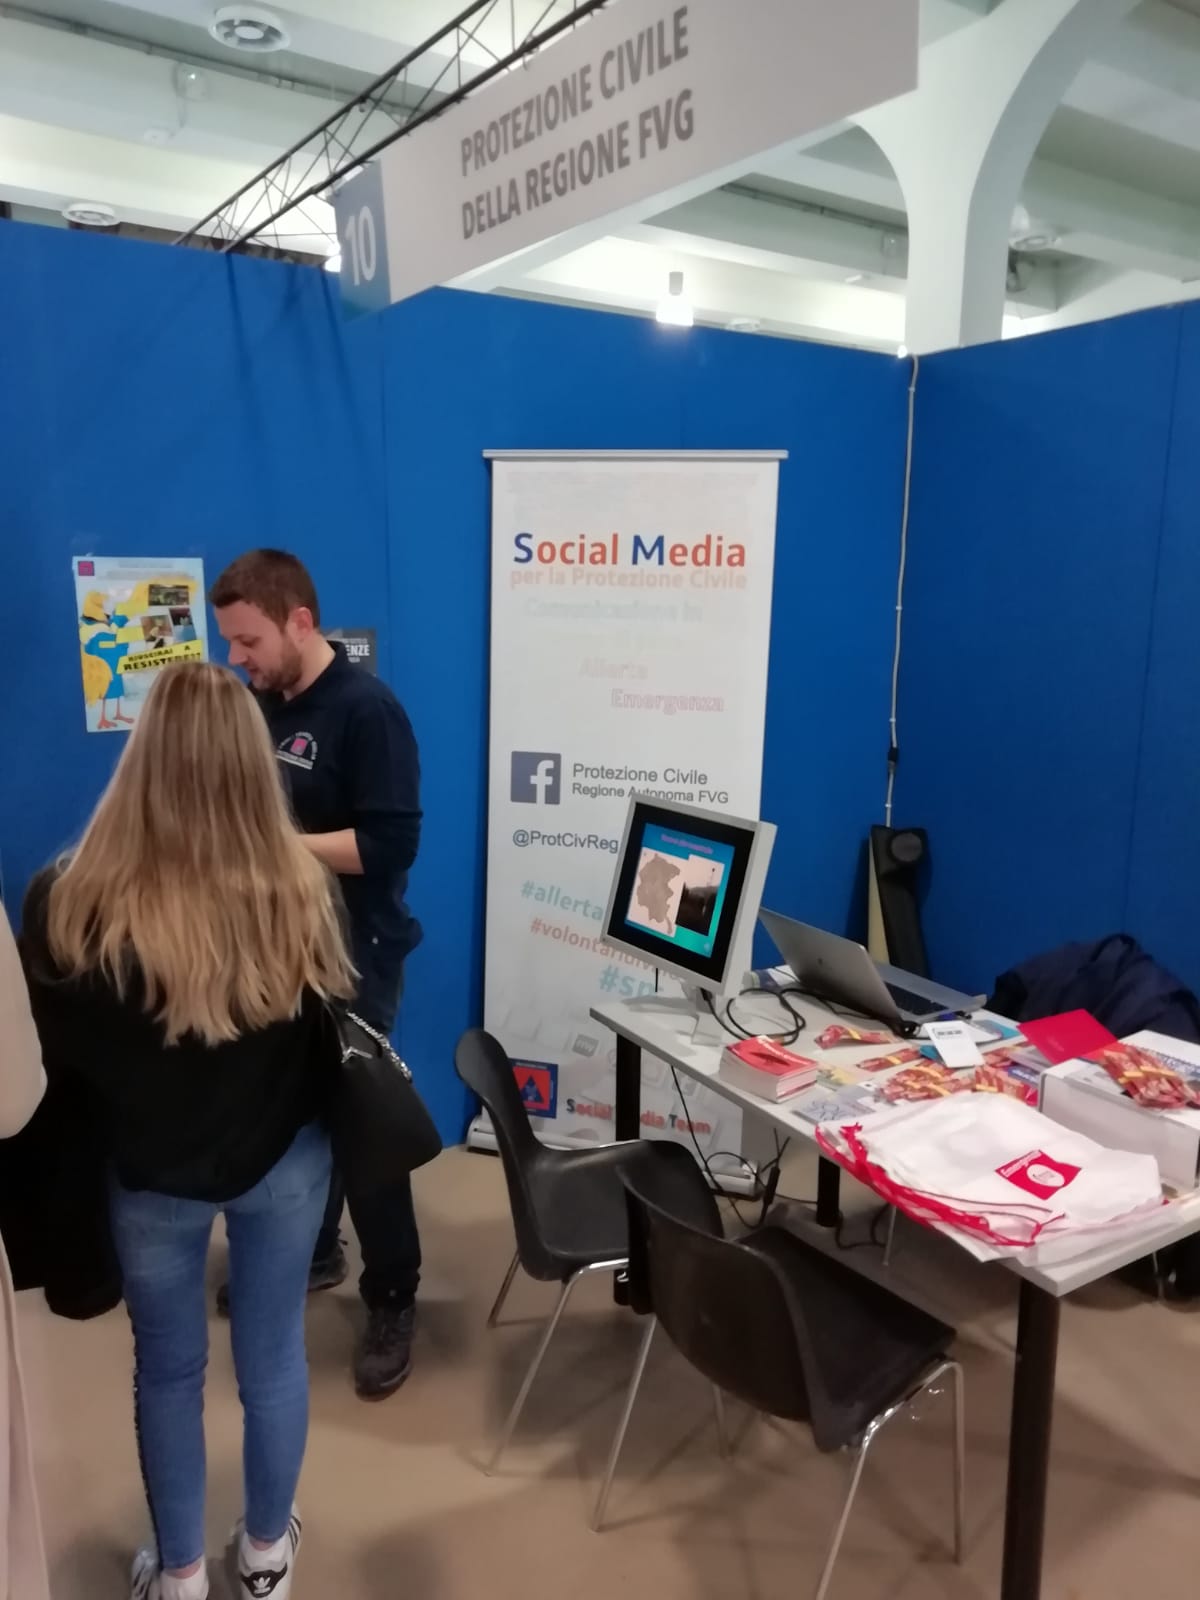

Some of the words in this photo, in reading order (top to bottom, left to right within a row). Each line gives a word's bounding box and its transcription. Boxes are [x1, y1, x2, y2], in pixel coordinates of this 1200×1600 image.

[461, 64, 593, 177] PROTEZIONE
[600, 5, 689, 100] CIVILE
[462, 177, 521, 240] DELLA
[526, 119, 631, 211] REGIONE
[639, 88, 695, 160] FVG
[345, 205, 377, 287] 10
[513, 532, 619, 564] Social
[631, 533, 746, 567] Media
[509, 568, 542, 590] per
[549, 567, 566, 586] la
[573, 568, 684, 589] Protezione
[689, 569, 748, 590] Civile
[610, 687, 724, 715] Emergenza
[573, 763, 658, 783] Protezione
[664, 768, 708, 785] Civile
[572, 783, 625, 798] Regione
[698, 790, 729, 804] FVG
[566, 1098, 613, 1120] Social
[669, 1114, 711, 1134] Team
